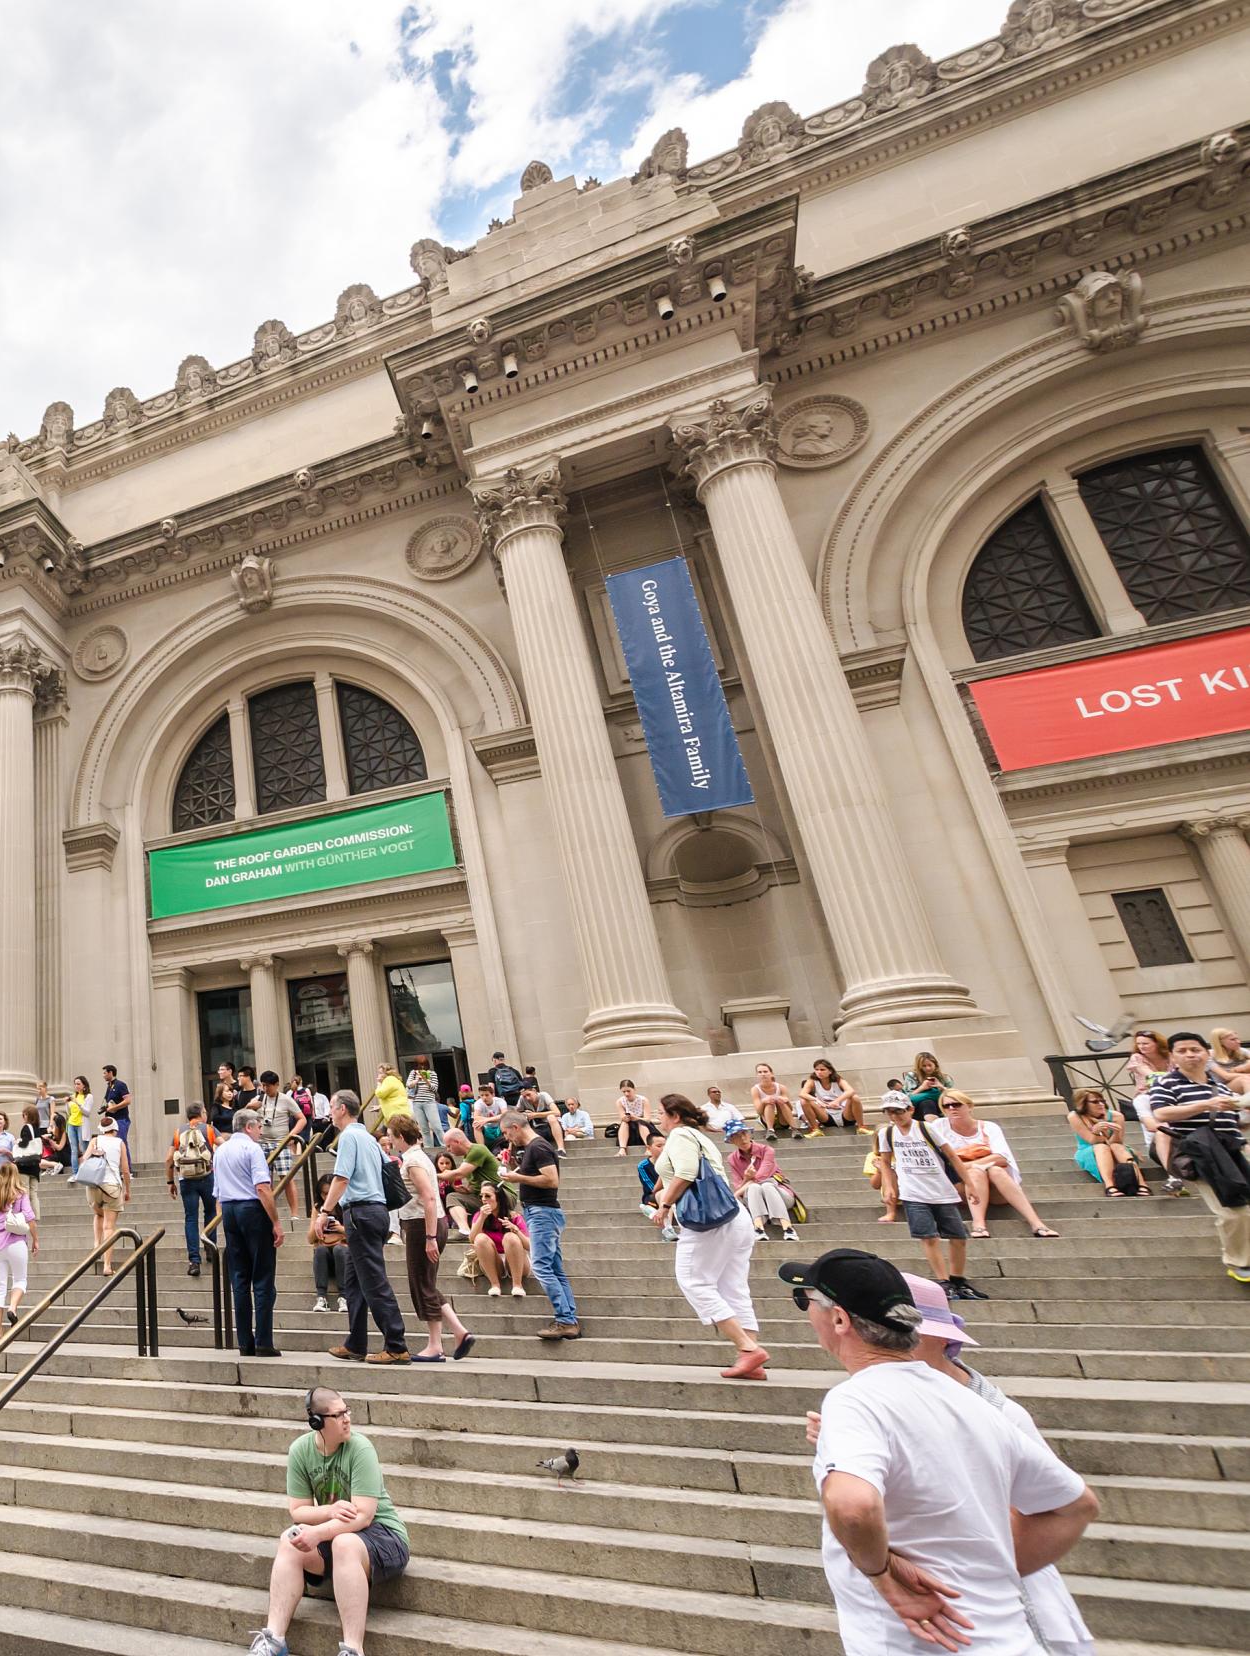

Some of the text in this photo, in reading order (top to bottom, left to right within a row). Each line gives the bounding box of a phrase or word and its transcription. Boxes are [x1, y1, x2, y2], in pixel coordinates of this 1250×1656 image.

[641, 579, 711, 789] Goya and the Altamira Family
[1075, 664, 1250, 719] LOST KI
[205, 839, 415, 889] DAN GRAHAM WITH GÜNTHER VOGT
[213, 823, 413, 871] THE ROOF GARDEN COMMISSION:
